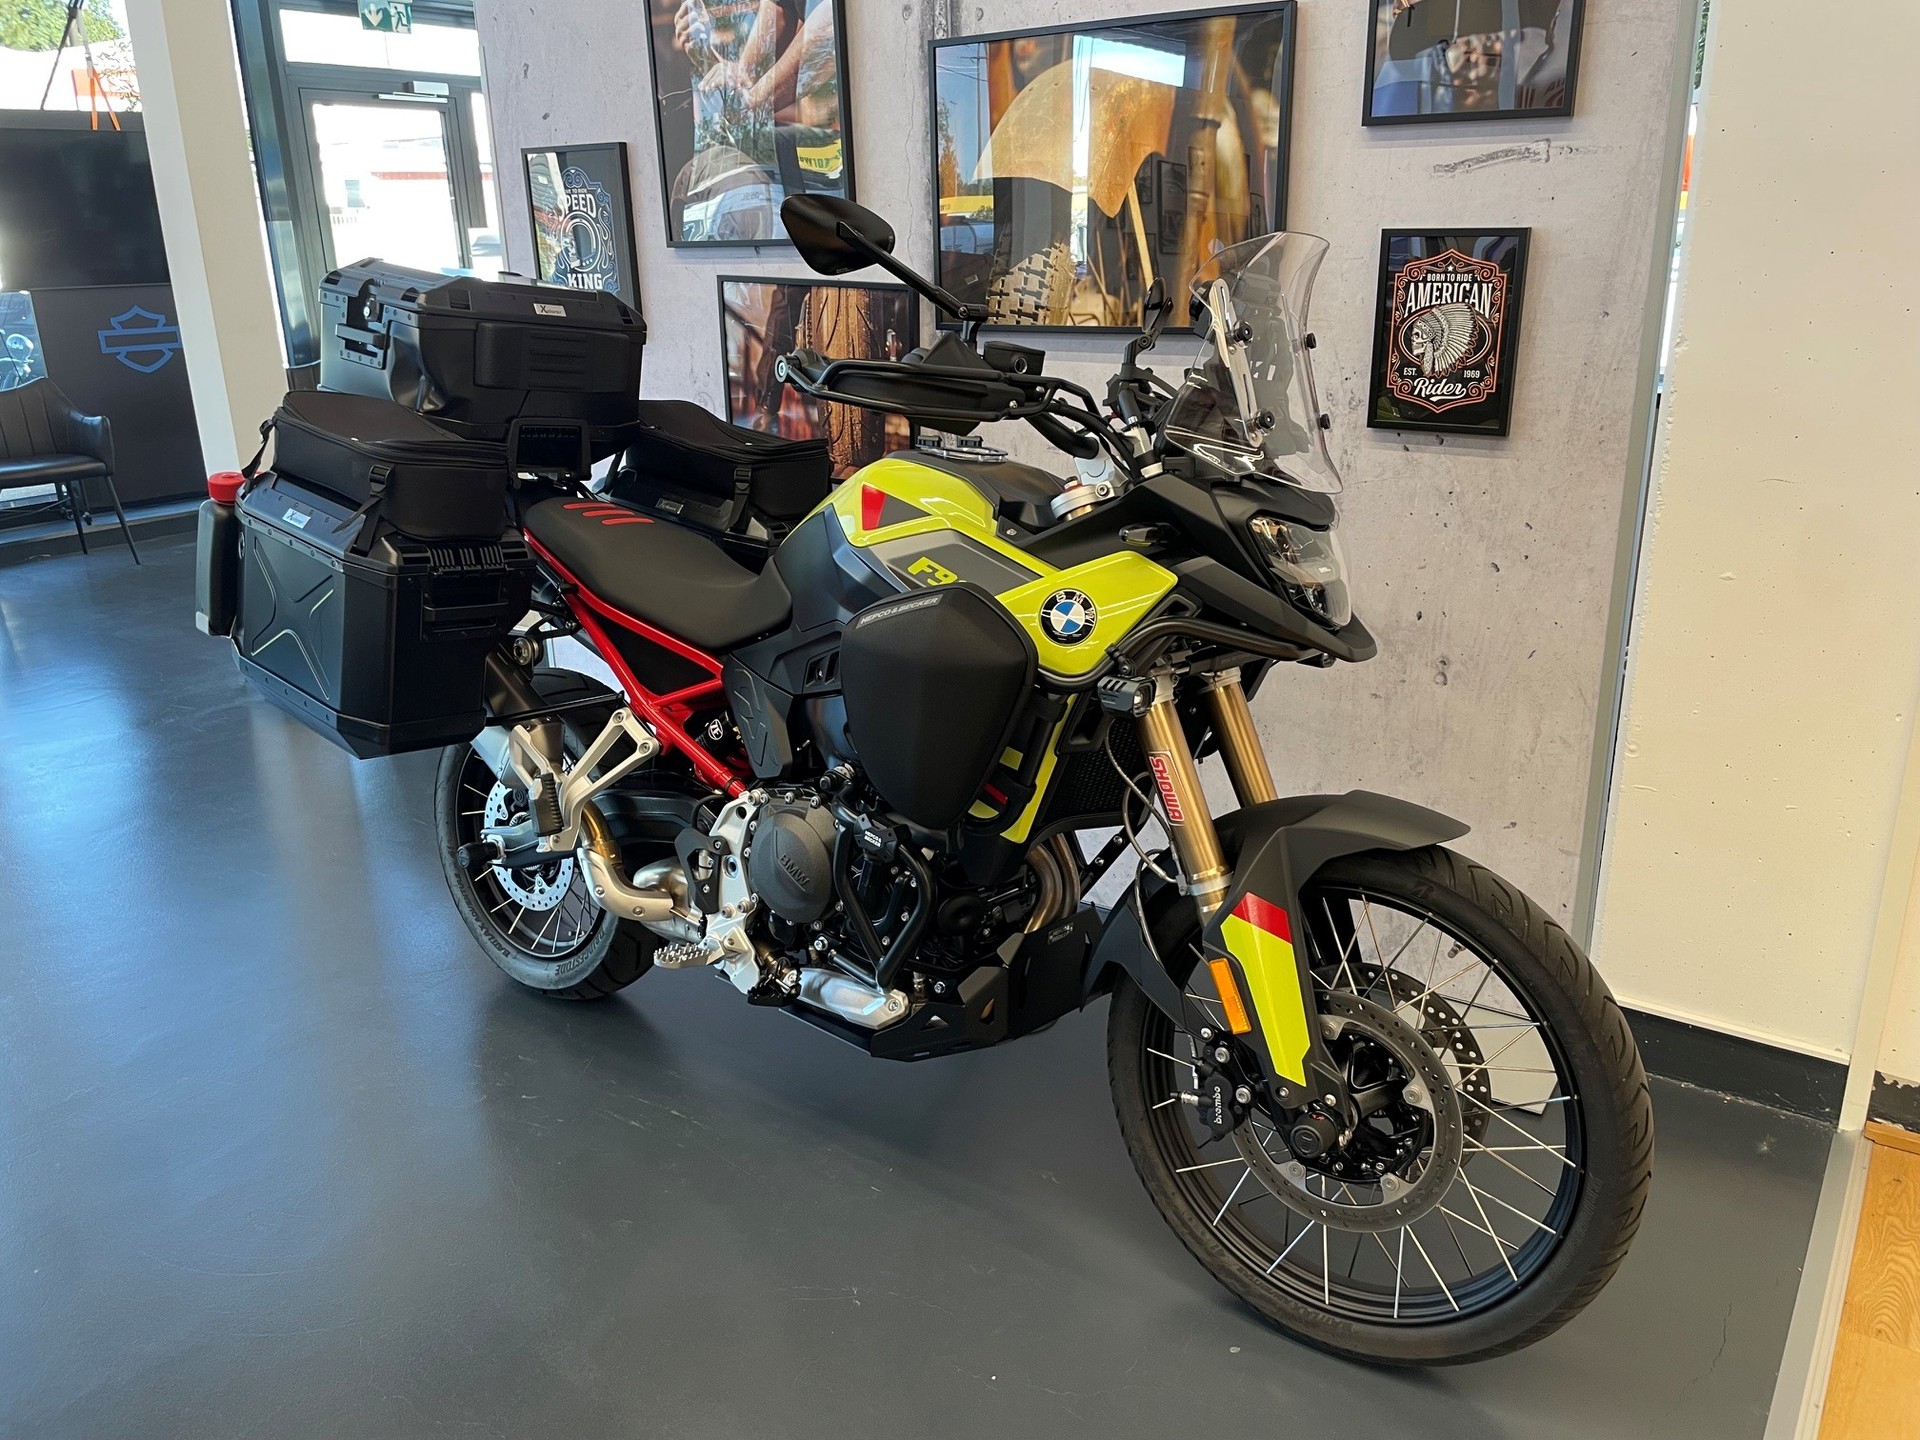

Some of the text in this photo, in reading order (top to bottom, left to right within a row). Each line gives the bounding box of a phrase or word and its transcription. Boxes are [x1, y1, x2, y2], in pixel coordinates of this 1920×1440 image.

[567, 273, 603, 290] KING
[1427, 273, 1473, 282] BORN TO RIDE
[1403, 282, 1494, 319] AMERICAN
[1403, 367, 1480, 379] EST. 1969
[1413, 377, 1467, 402] Rider
[907, 556, 967, 586] F9
[860, 609, 890, 625] HEPCO
[898, 597, 939, 612] BECKER
[1149, 756, 1185, 821] SHOWA
[780, 854, 810, 884] BMW
[1213, 1085, 1223, 1125] brembo
